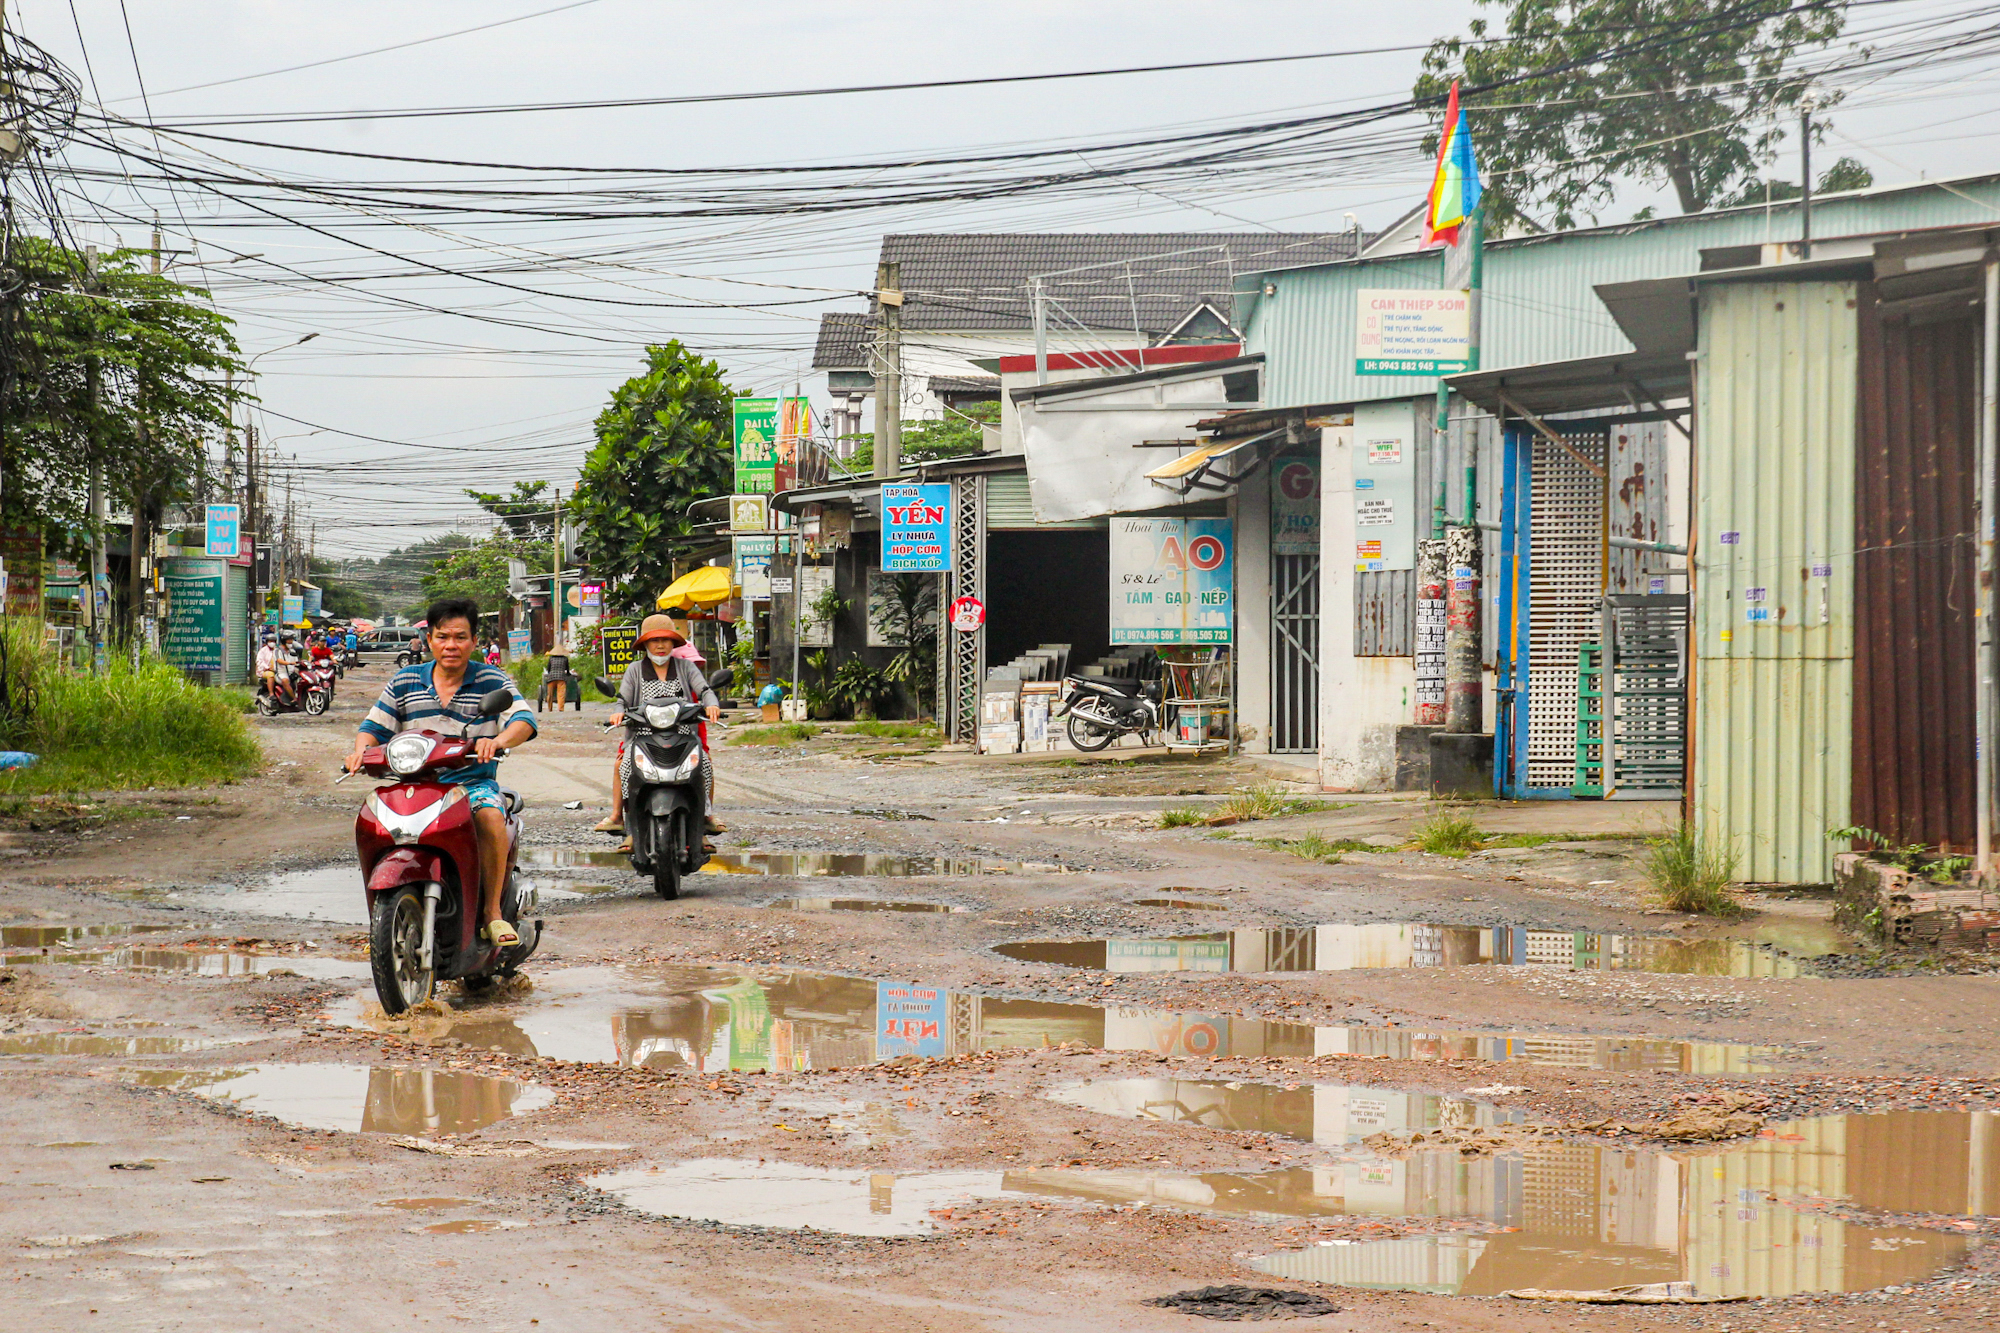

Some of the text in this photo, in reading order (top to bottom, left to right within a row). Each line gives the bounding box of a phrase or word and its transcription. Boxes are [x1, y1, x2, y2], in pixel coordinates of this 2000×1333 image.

[1379, 361, 1399, 370] 0943
[1401, 361, 1416, 370] 882
[1418, 361, 1434, 370] 945
[208, 508, 236, 521] TOÁN
[888, 498, 944, 524] YẾN
[892, 531, 936, 542] LY NHỰA
[211, 542, 233, 553] DUY
[741, 544, 754, 553] ĐẠI
[755, 542, 765, 551] LÝ
[892, 545, 941, 557] HỘP CƠM
[892, 556, 941, 570] BỊCH XỐP
[1119, 535, 1225, 580] ẠO
[1133, 574, 1143, 584] &
[1165, 592, 1191, 606] GẠO
[1201, 588, 1228, 604] NẾP
[1419, 600, 1445, 608] CHO VAY
[1127, 630, 1159, 640] 0974.894
[1161, 630, 1174, 639] 566
[1214, 630, 1227, 639] 733
[1432, 626, 1444, 634] VAY
[610, 637, 632, 650] CẮT
[610, 650, 633, 661] TÓC
